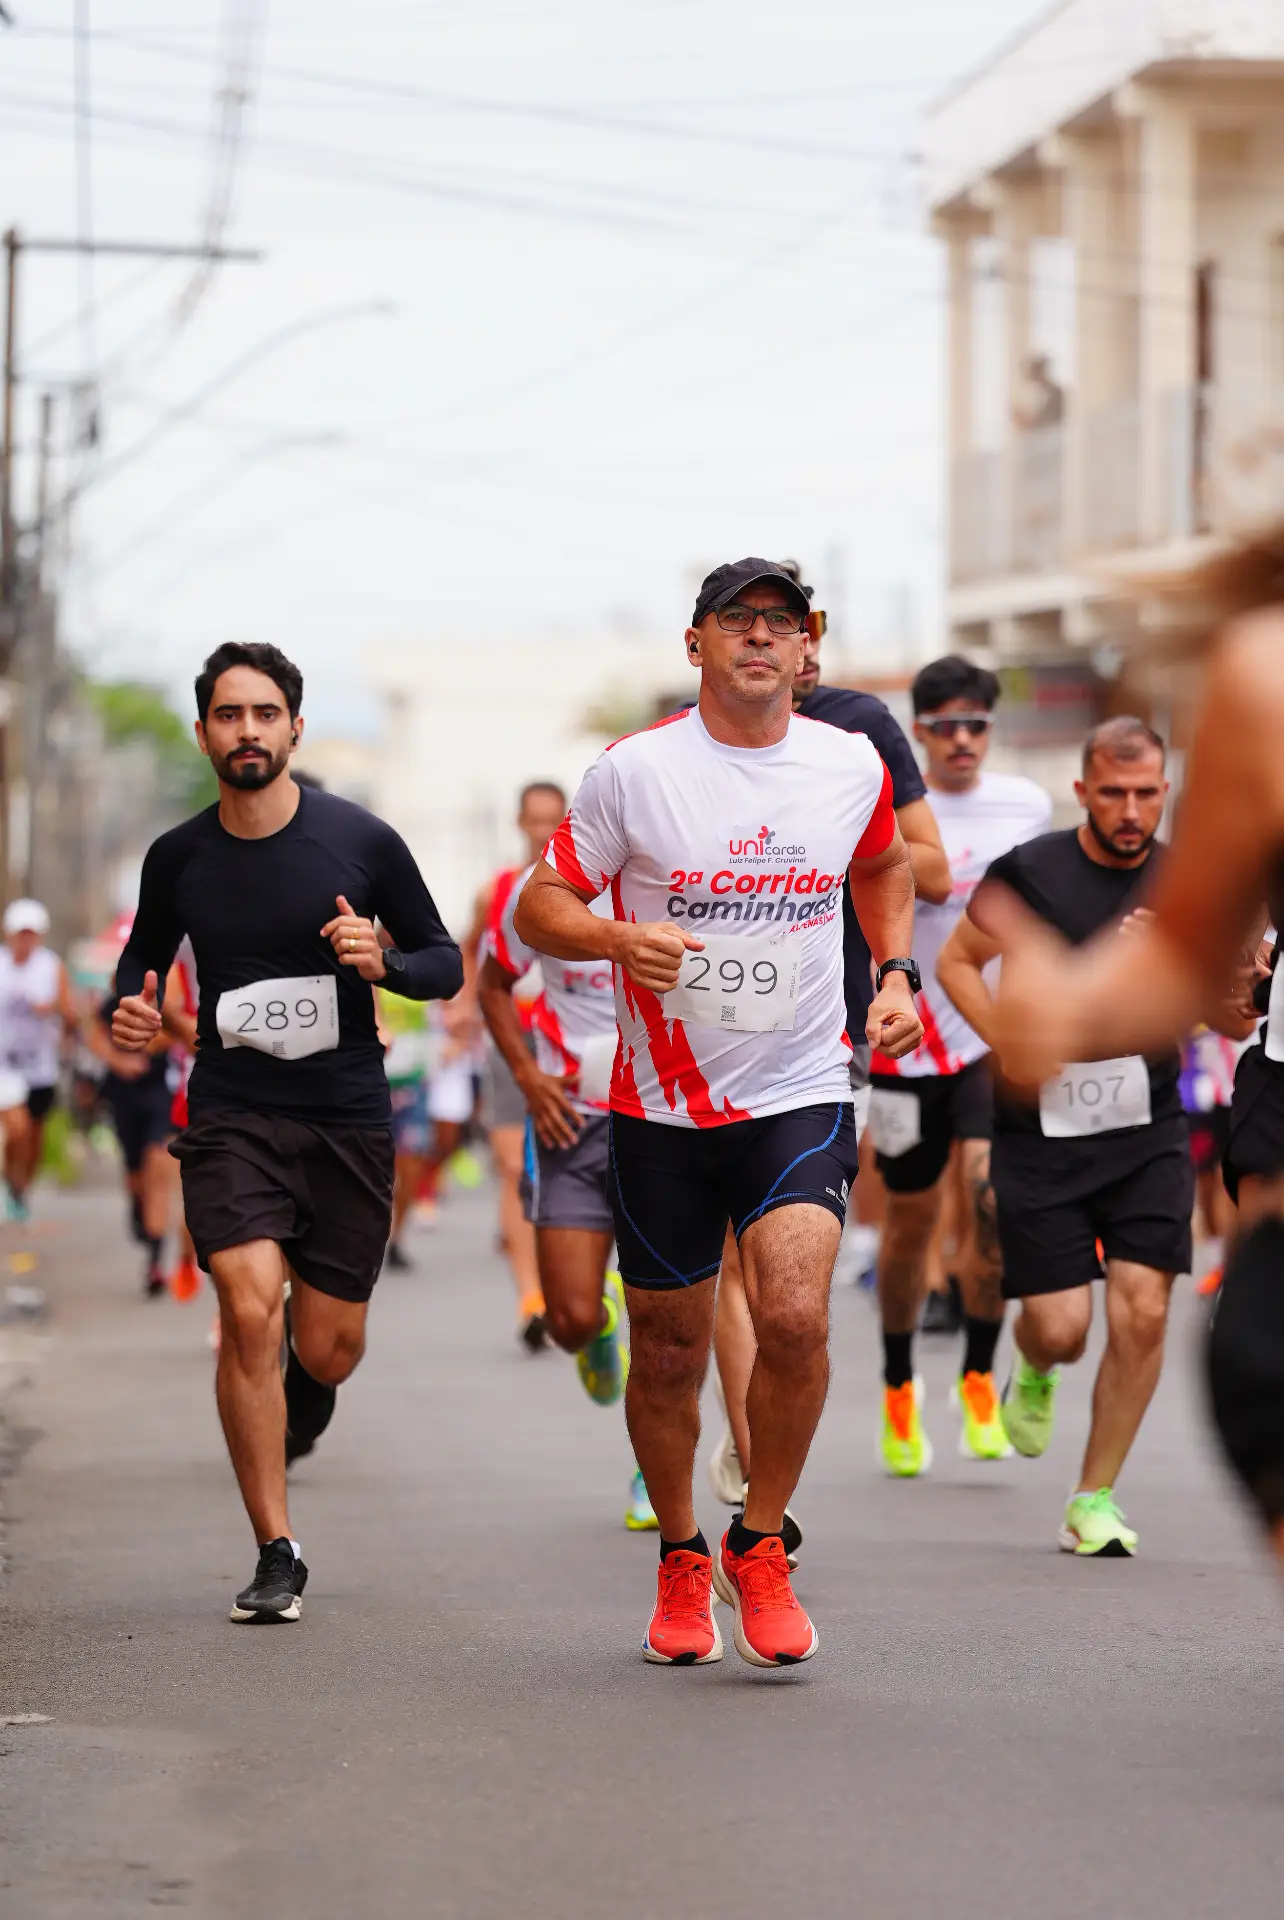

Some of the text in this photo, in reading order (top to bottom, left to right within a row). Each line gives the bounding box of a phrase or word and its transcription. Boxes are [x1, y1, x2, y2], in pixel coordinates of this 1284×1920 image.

[710, 866, 834, 895] Corrida
[667, 892, 839, 922] Caminhad
[684, 956, 778, 995] 299
[236, 998, 318, 1033] 289
[1061, 1075, 1125, 1108] 107
